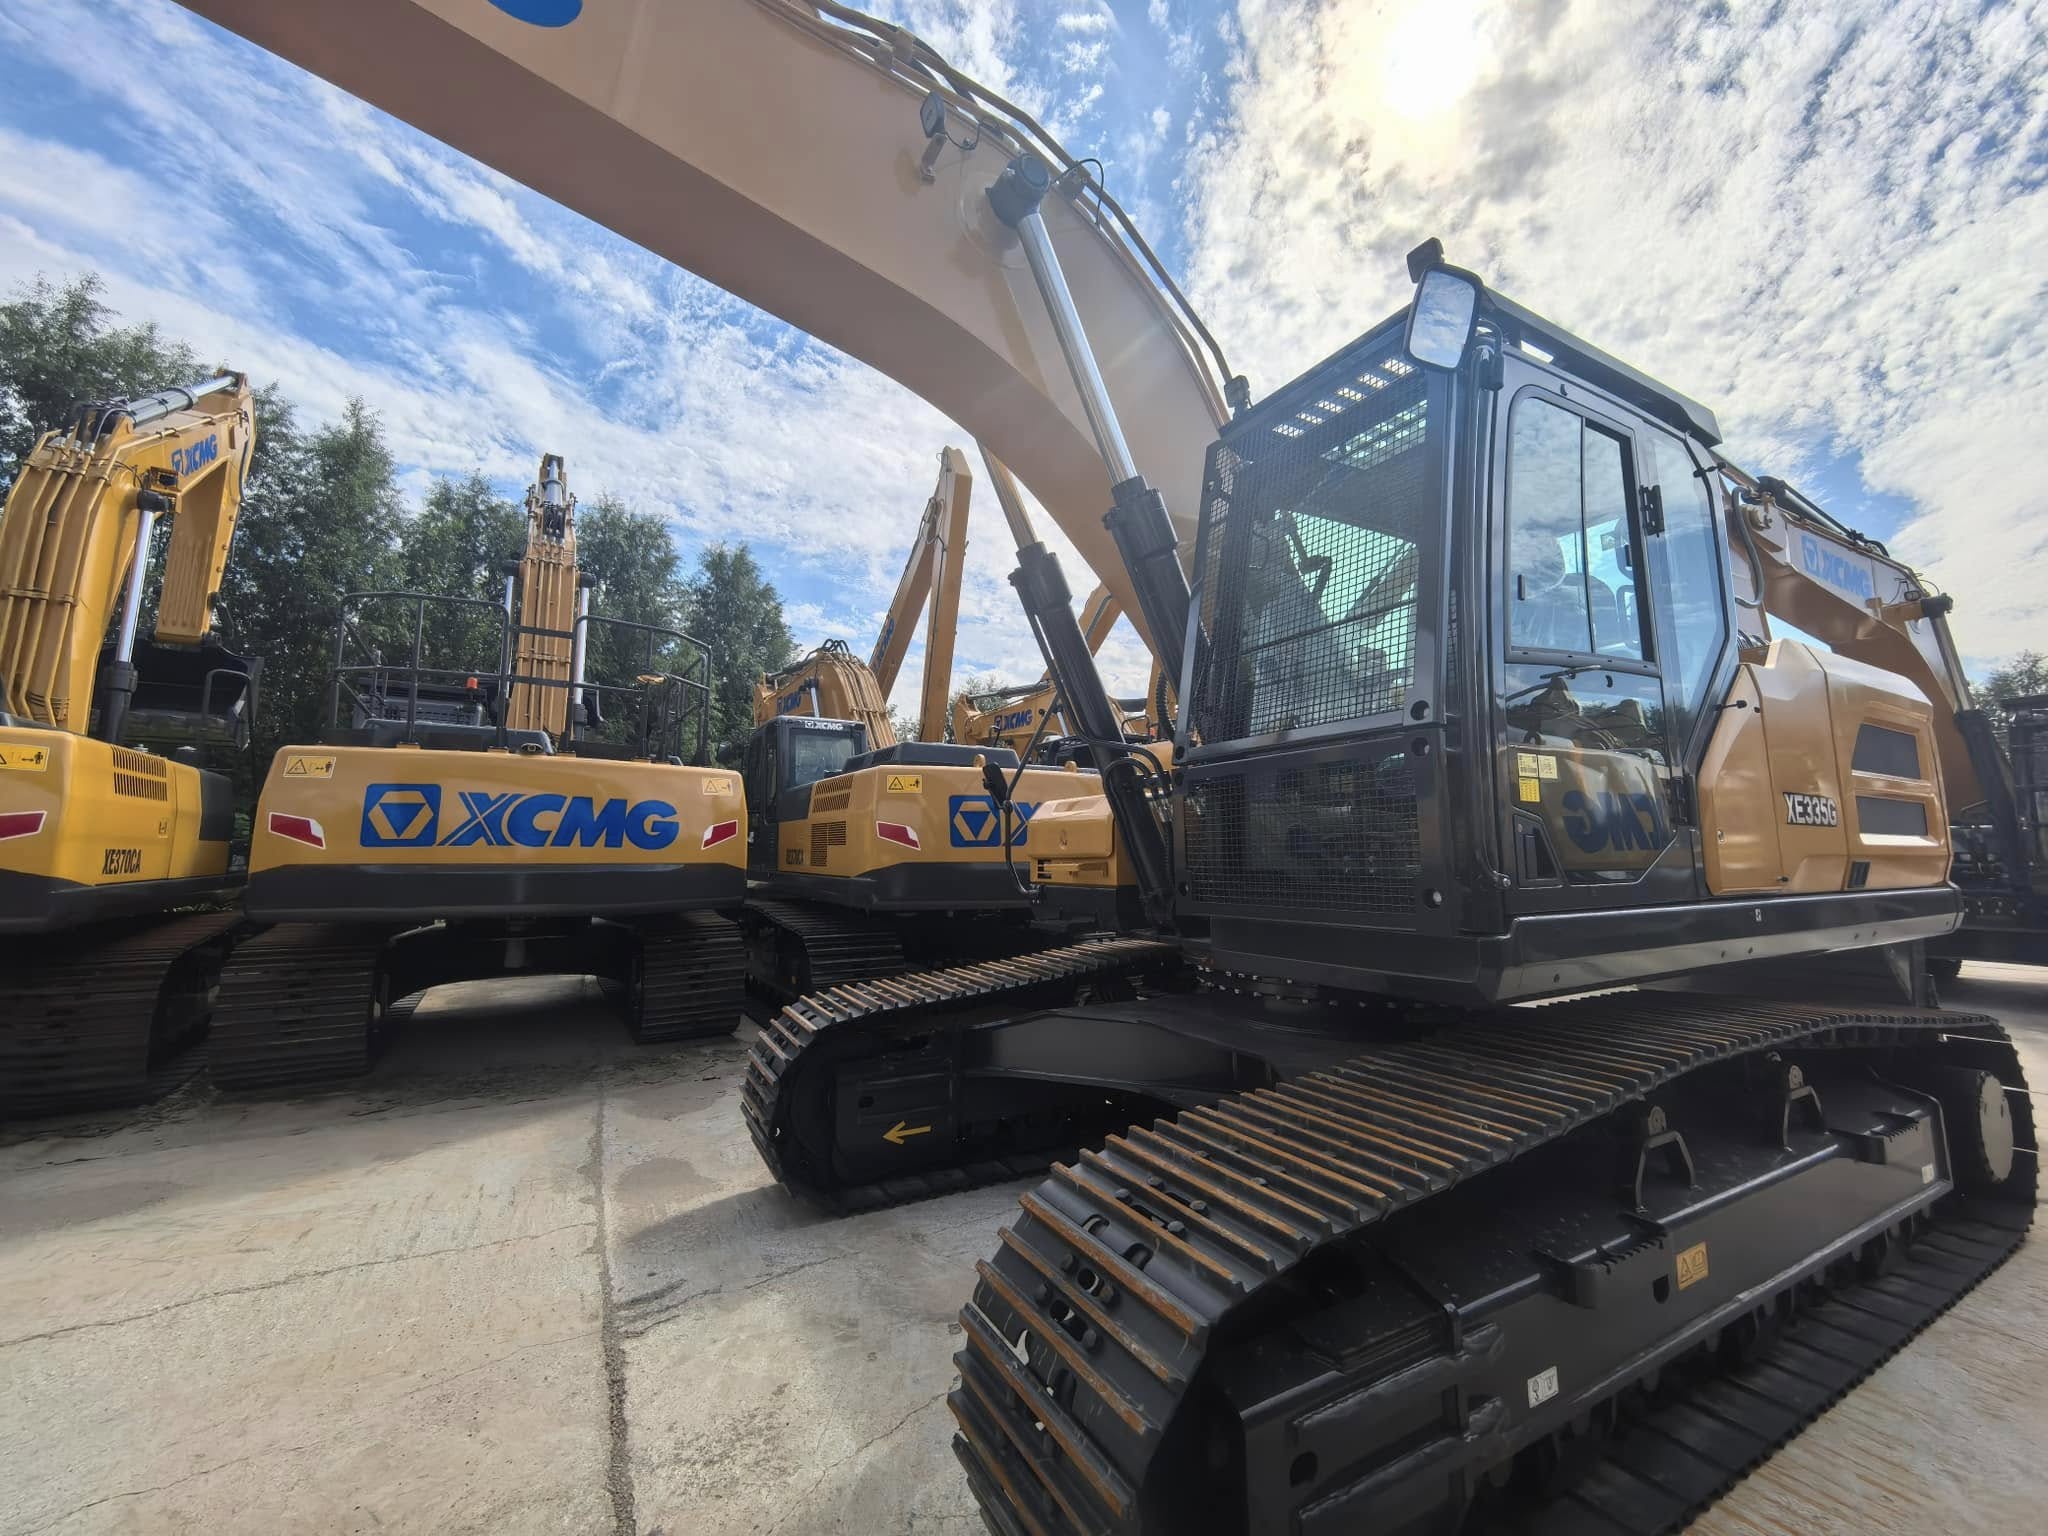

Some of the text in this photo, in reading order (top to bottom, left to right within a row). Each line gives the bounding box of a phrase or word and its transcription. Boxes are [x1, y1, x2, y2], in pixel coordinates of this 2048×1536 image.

[184, 434, 217, 475] XCMG
[815, 721, 843, 731] XCMG
[1004, 709, 1032, 730] XCMG
[436, 792, 680, 850] XCMG
[1784, 793, 1837, 826] XE335G
[102, 849, 141, 875] XE370CA
